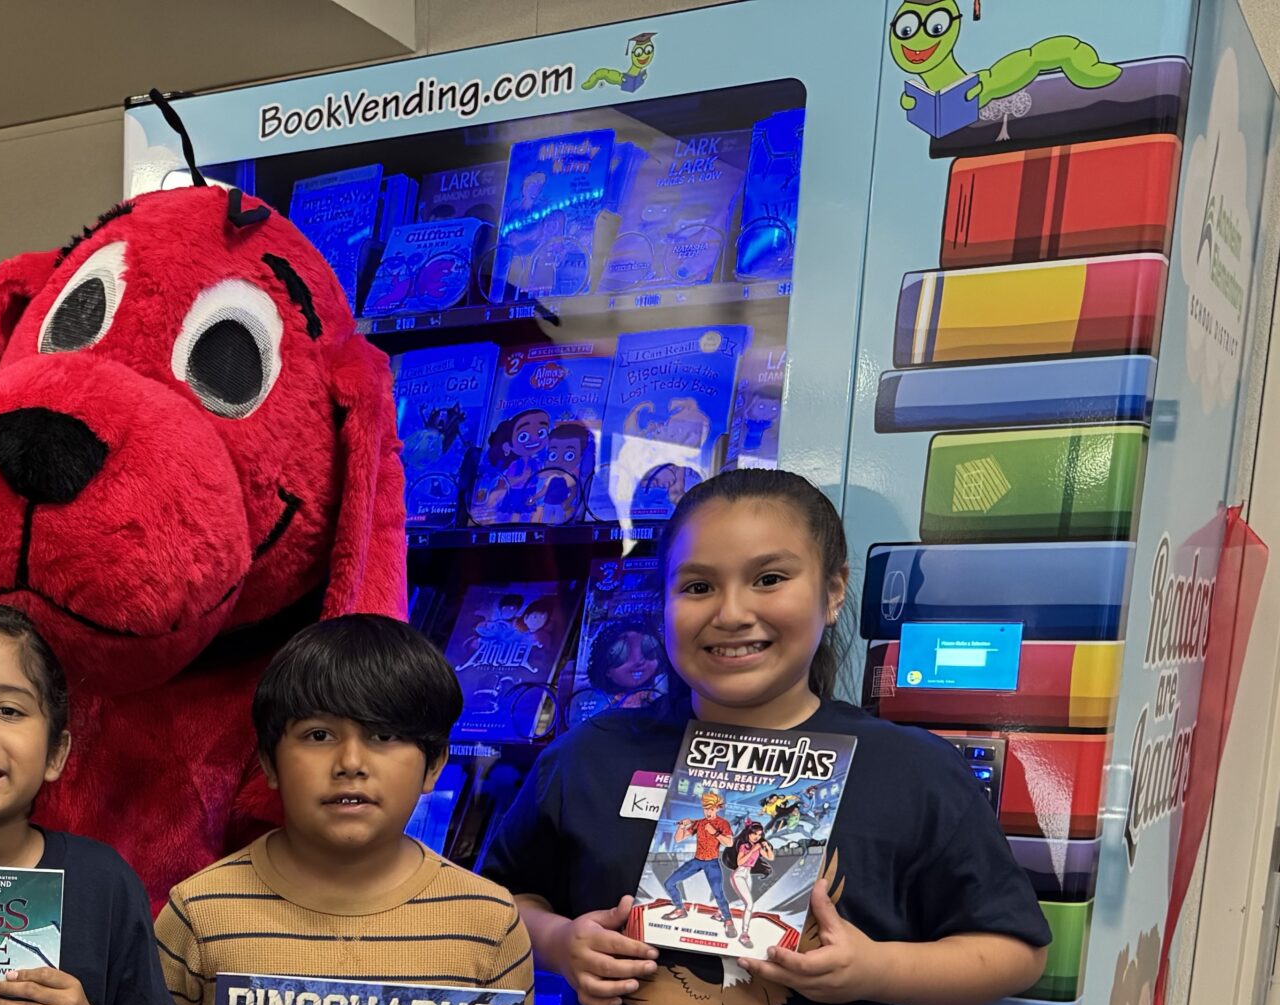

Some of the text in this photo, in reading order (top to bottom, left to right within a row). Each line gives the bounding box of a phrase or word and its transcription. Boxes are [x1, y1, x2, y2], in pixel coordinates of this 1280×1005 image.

[261, 64, 574, 139] BookVending.com
[673, 137, 721, 158] LARK
[669, 156, 719, 176] LARK
[440, 169, 480, 192] LARK
[405, 226, 465, 245] Clifford
[641, 348, 662, 360] Can
[665, 341, 695, 356] Read!
[509, 359, 519, 374] 2
[535, 367, 565, 380] Alma's
[627, 359, 720, 385] Biscuit and the
[446, 375, 480, 392] Cat
[620, 376, 719, 404] Lost Teddy Bear
[603, 570, 615, 583] 2
[1154, 669, 1179, 722] are
[688, 768, 776, 786] VIRTUAL REALITY
[702, 778, 756, 793] MADNESS!
[631, 793, 660, 814] Kim
